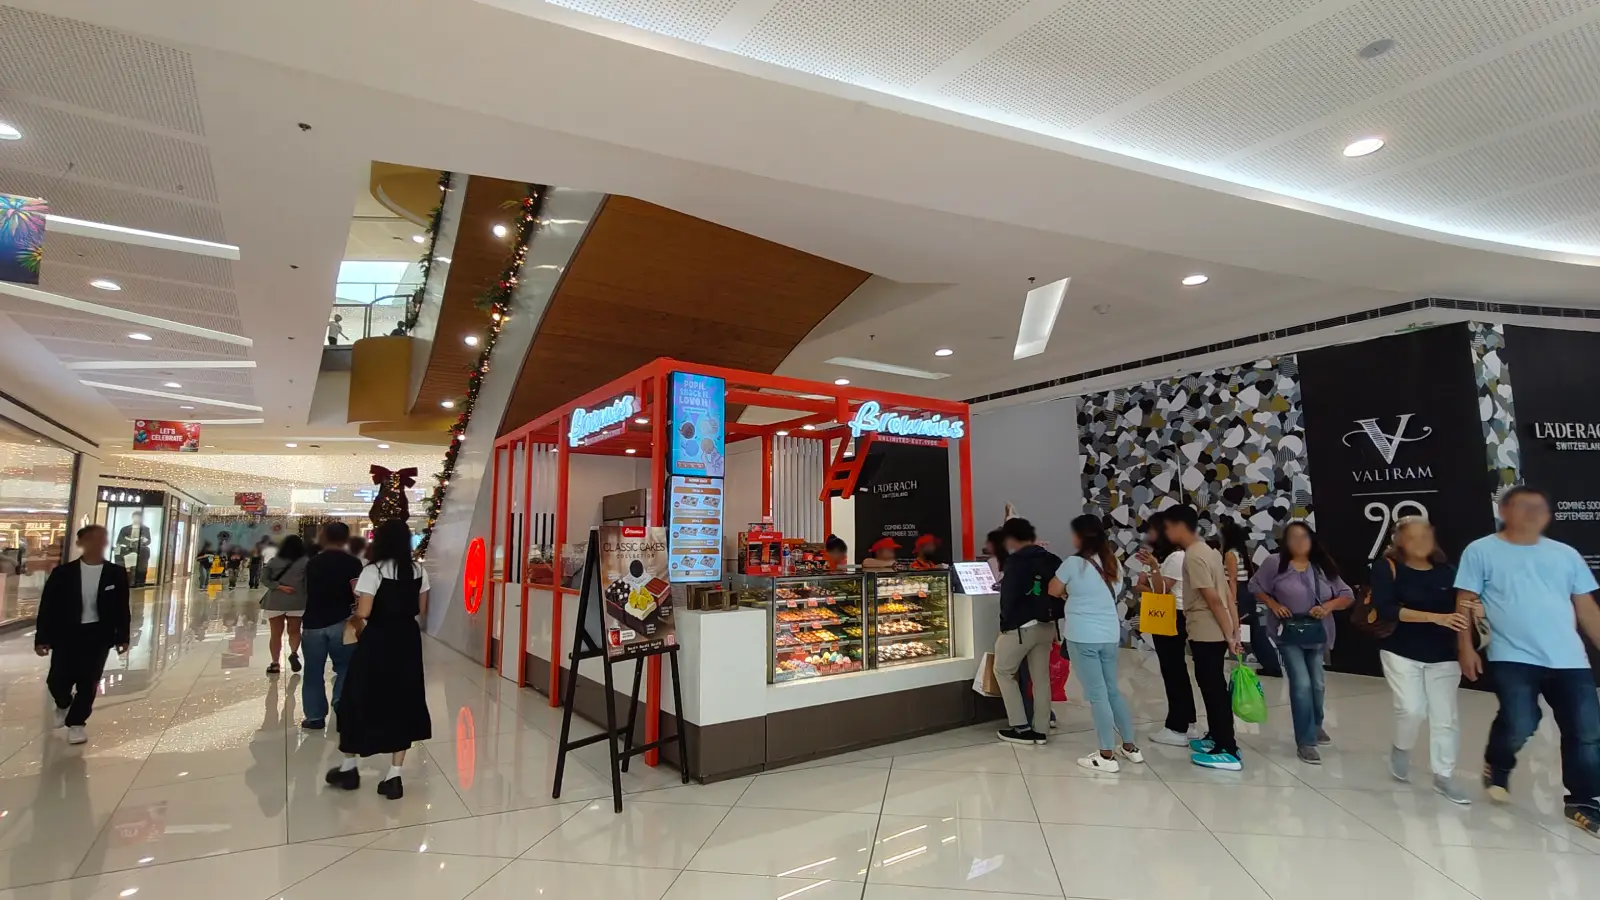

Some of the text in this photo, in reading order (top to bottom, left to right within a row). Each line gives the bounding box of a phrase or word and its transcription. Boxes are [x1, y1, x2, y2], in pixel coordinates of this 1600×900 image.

[848, 400, 965, 439] Brownies
[159, 427, 176, 435] LET'S
[151, 434, 183, 442] CELEBRATE
[1555, 441, 1600, 451] SWITZERLAN
[1351, 465, 1434, 482] VALIRAM
[1557, 501, 1586, 510] COMING
[1554, 511, 1595, 521] SEPTEMBER
[602, 542, 666, 552] CLASSIC CAKES
[1148, 609, 1166, 618] KKV
